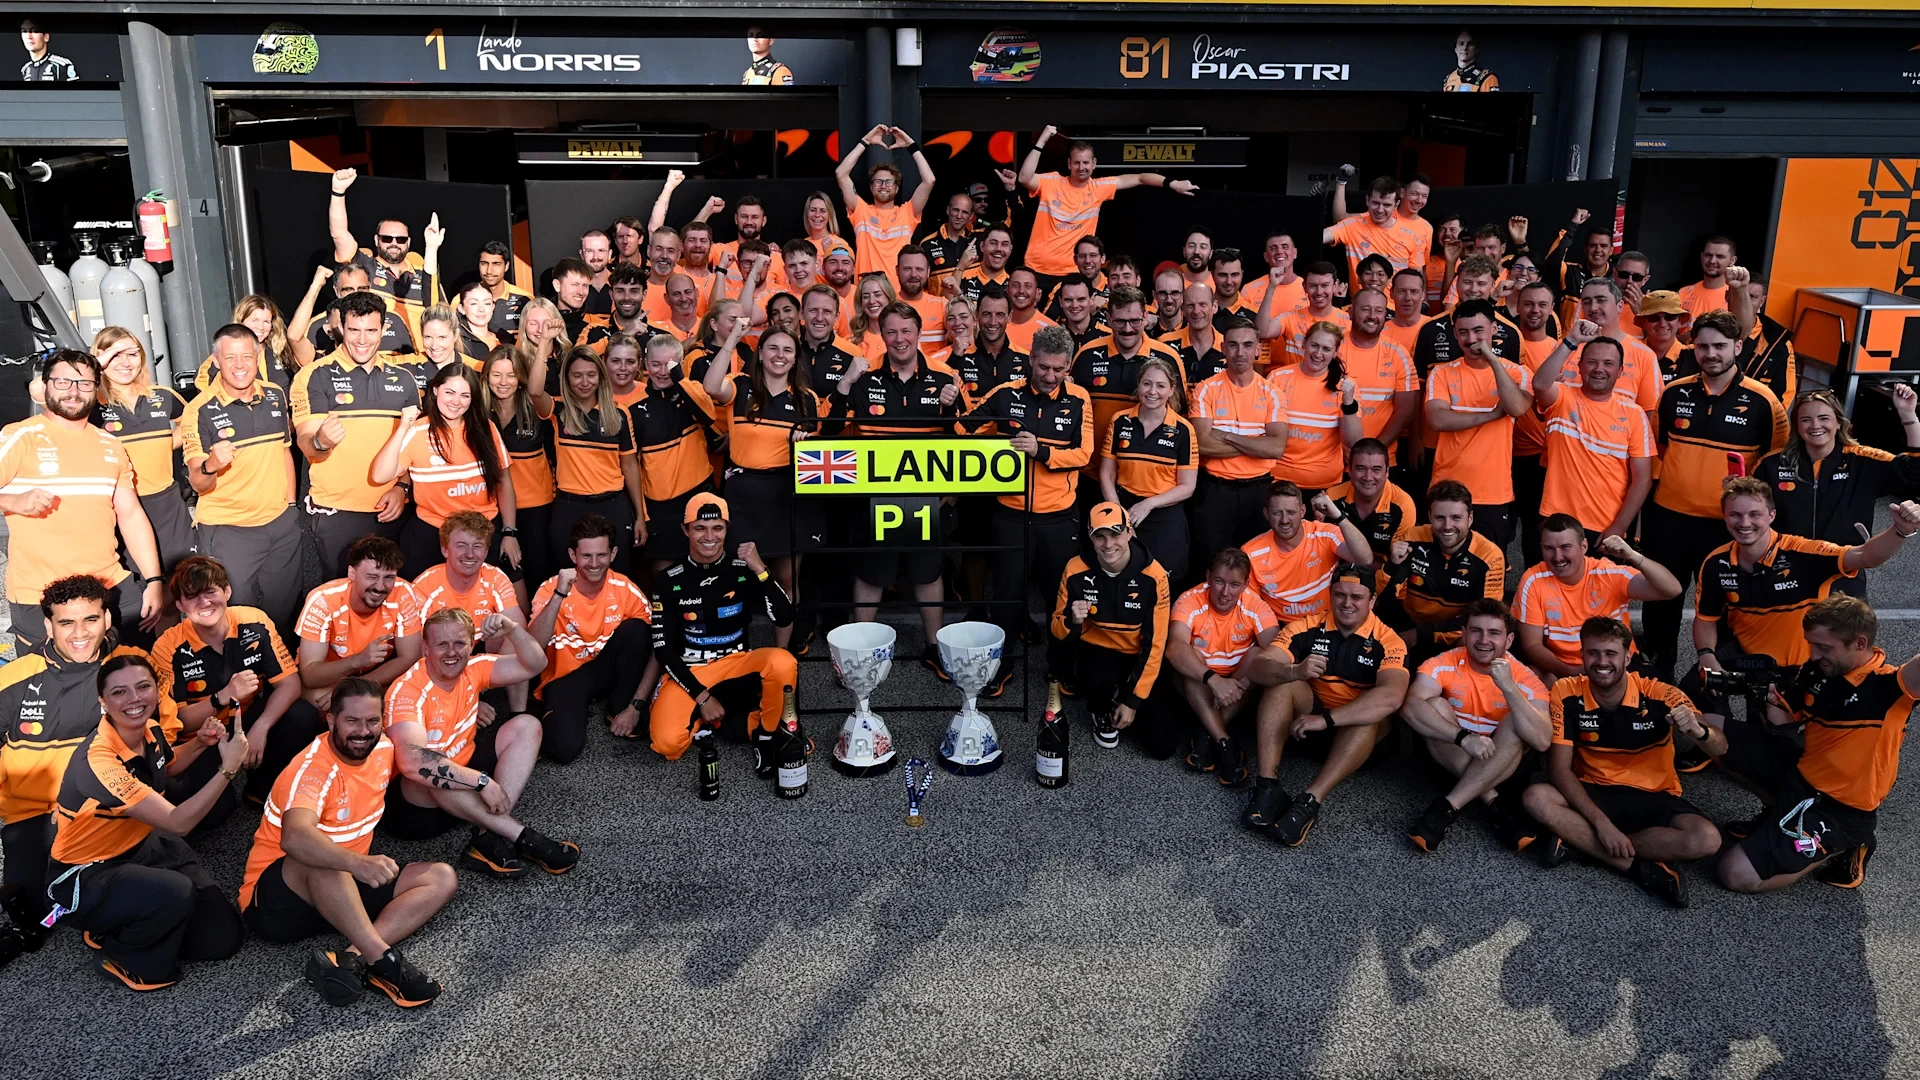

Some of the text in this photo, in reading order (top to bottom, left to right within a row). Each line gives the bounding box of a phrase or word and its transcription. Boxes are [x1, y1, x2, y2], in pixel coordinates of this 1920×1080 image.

[476, 18, 523, 58] Lando
[424, 28, 447, 71] 1
[1192, 33, 1246, 62] Oscar
[479, 53, 641, 72] NORRIS
[1119, 36, 1171, 79] 81
[1191, 62, 1350, 81] PIASTRI
[200, 200, 209, 216] 4
[333, 381, 353, 389] DELL
[868, 393, 886, 401] DELL
[1676, 407, 1693, 415] DELL
[213, 418, 232, 428] DELL
[867, 449, 1023, 483] LANDO
[1410, 563, 1427, 575] DELL
[679, 598, 703, 606] Android
[182, 666, 206, 678] DELL
[20, 707, 45, 716] DELL
[1579, 721, 1599, 729] DELL
[108, 775, 131, 789] okta
